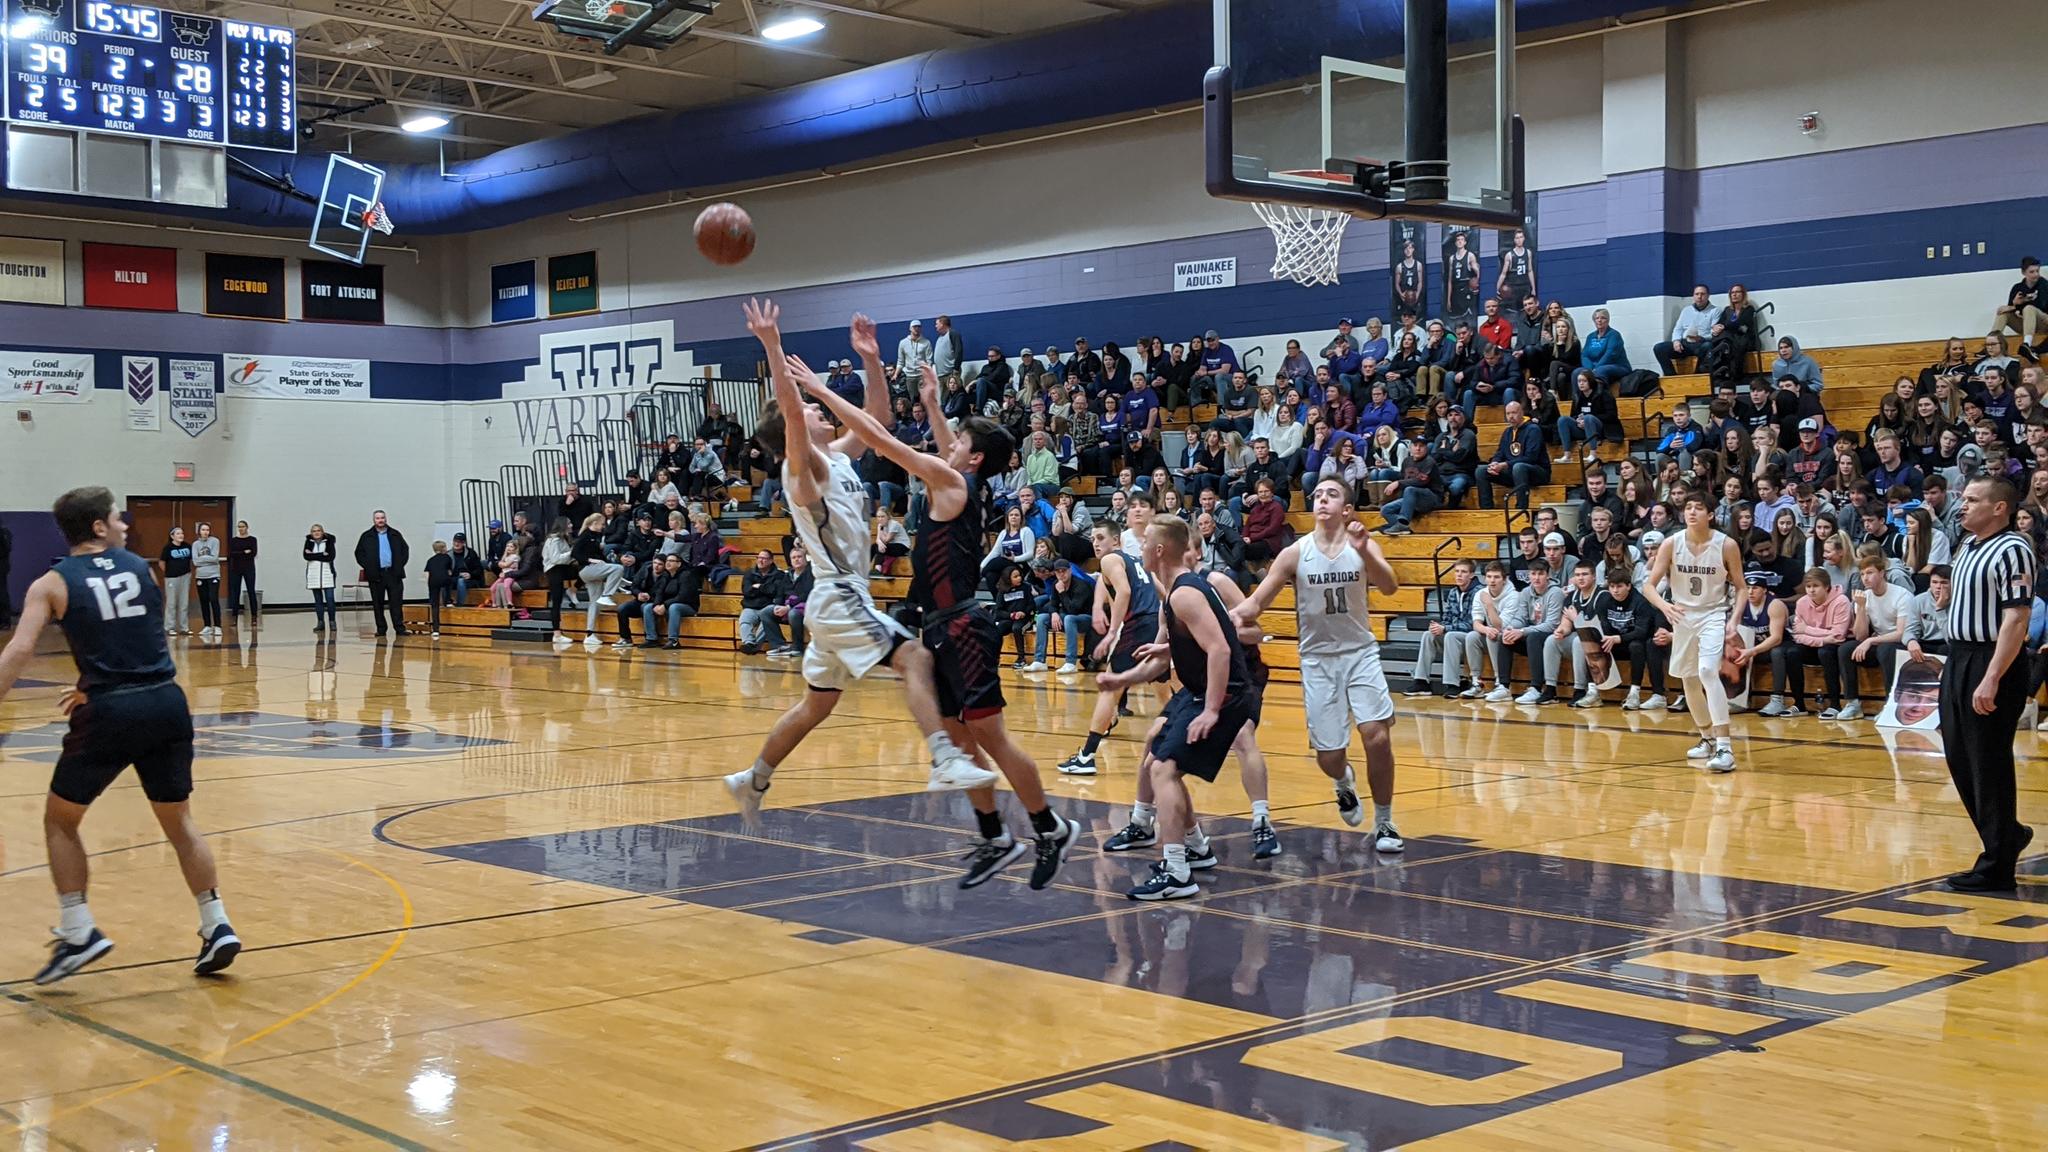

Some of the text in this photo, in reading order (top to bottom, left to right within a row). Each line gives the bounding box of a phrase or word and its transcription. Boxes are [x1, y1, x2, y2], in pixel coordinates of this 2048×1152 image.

[87, 3, 158, 37] 15:45
[104, 44, 135, 56] PERIOD
[170, 46, 209, 63] GUEST
[281, 46, 290, 60] 7
[29, 44, 67, 73] 39
[111, 57, 126, 80] 2
[239, 58, 290, 77] 2 2 4
[18, 73, 48, 84] FOULS
[57, 78, 81, 89] T.O.L.
[176, 63, 212, 93] 28
[92, 81, 148, 97] PLAYER FOUL
[239, 76, 290, 96] 4 2 3
[28, 84, 44, 107] 2
[62, 88, 77, 111] 5
[157, 89, 179, 101] T.O.L.
[188, 94, 214, 105] FOULS
[101, 94, 123, 116] 12
[131, 96, 145, 119] 3
[162, 101, 176, 123] 3
[281, 99, 291, 113] 3
[19, 109, 48, 120] SCORE
[198, 105, 212, 127] 3
[234, 110, 291, 131] 12 3 3
[105, 119, 135, 130] MATCH
[187, 128, 214, 140] SCORE
[0, 263, 46, 278] TOUGHTON
[1177, 260, 1233, 275] WAUNAKEE
[114, 270, 148, 284] MILTON
[1185, 274, 1223, 287] ADULTS
[223, 278, 267, 294] EDGEWOOD
[310, 284, 377, 300] FORT ATKINSON
[32, 359, 59, 368] Good
[8, 367, 84, 381] Sportsmanship
[279, 376, 364, 387] Player of the Year
[289, 369, 354, 379] State Girls Soccer
[173, 388, 213, 399] STATE
[304, 387, 340, 395] 2008-2009
[1676, 564, 1716, 575] WARRIORS
[1307, 571, 1360, 585] WARRIORS
[85, 571, 147, 621] 12
[1323, 587, 1348, 615] 11
